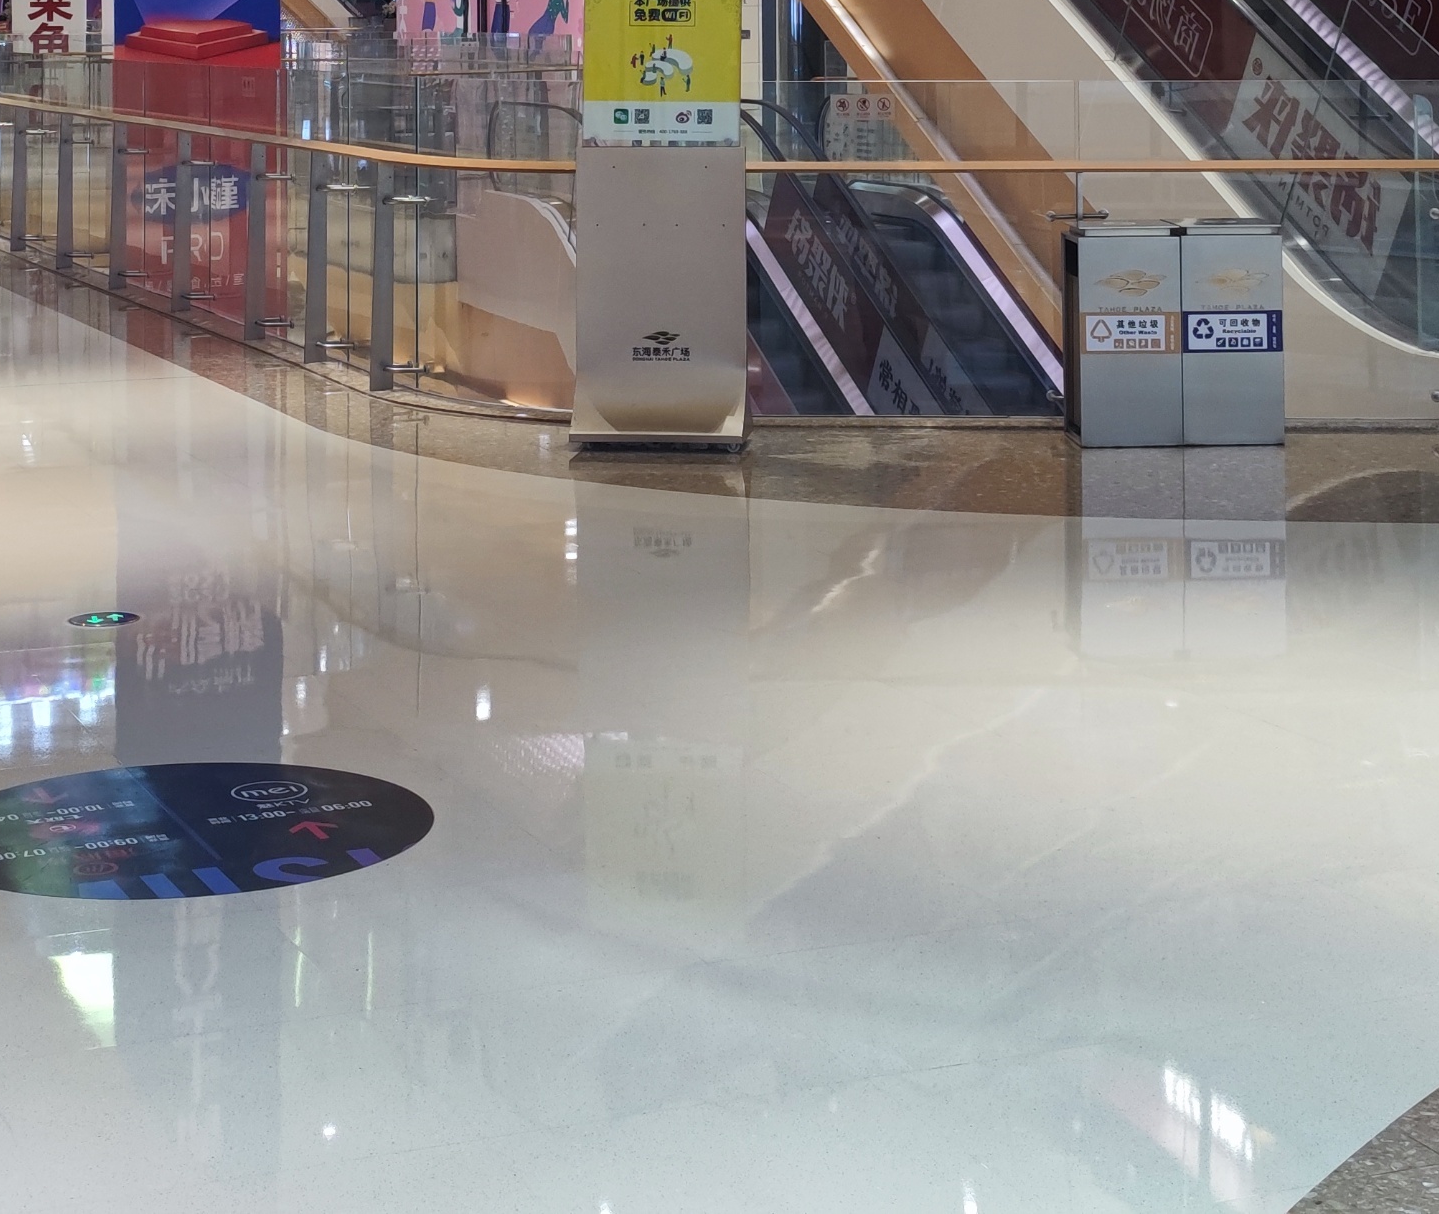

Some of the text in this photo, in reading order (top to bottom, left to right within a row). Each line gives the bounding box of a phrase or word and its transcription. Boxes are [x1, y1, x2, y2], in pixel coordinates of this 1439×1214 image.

[784, 208, 850, 333] 锅聚侠
[1116, 319, 1159, 330] 其他垃圾
[1218, 318, 1261, 328] 可回收物
[632, 346, 691, 357] 东海泰禾广场
[321, 800, 373, 813] 06:00
